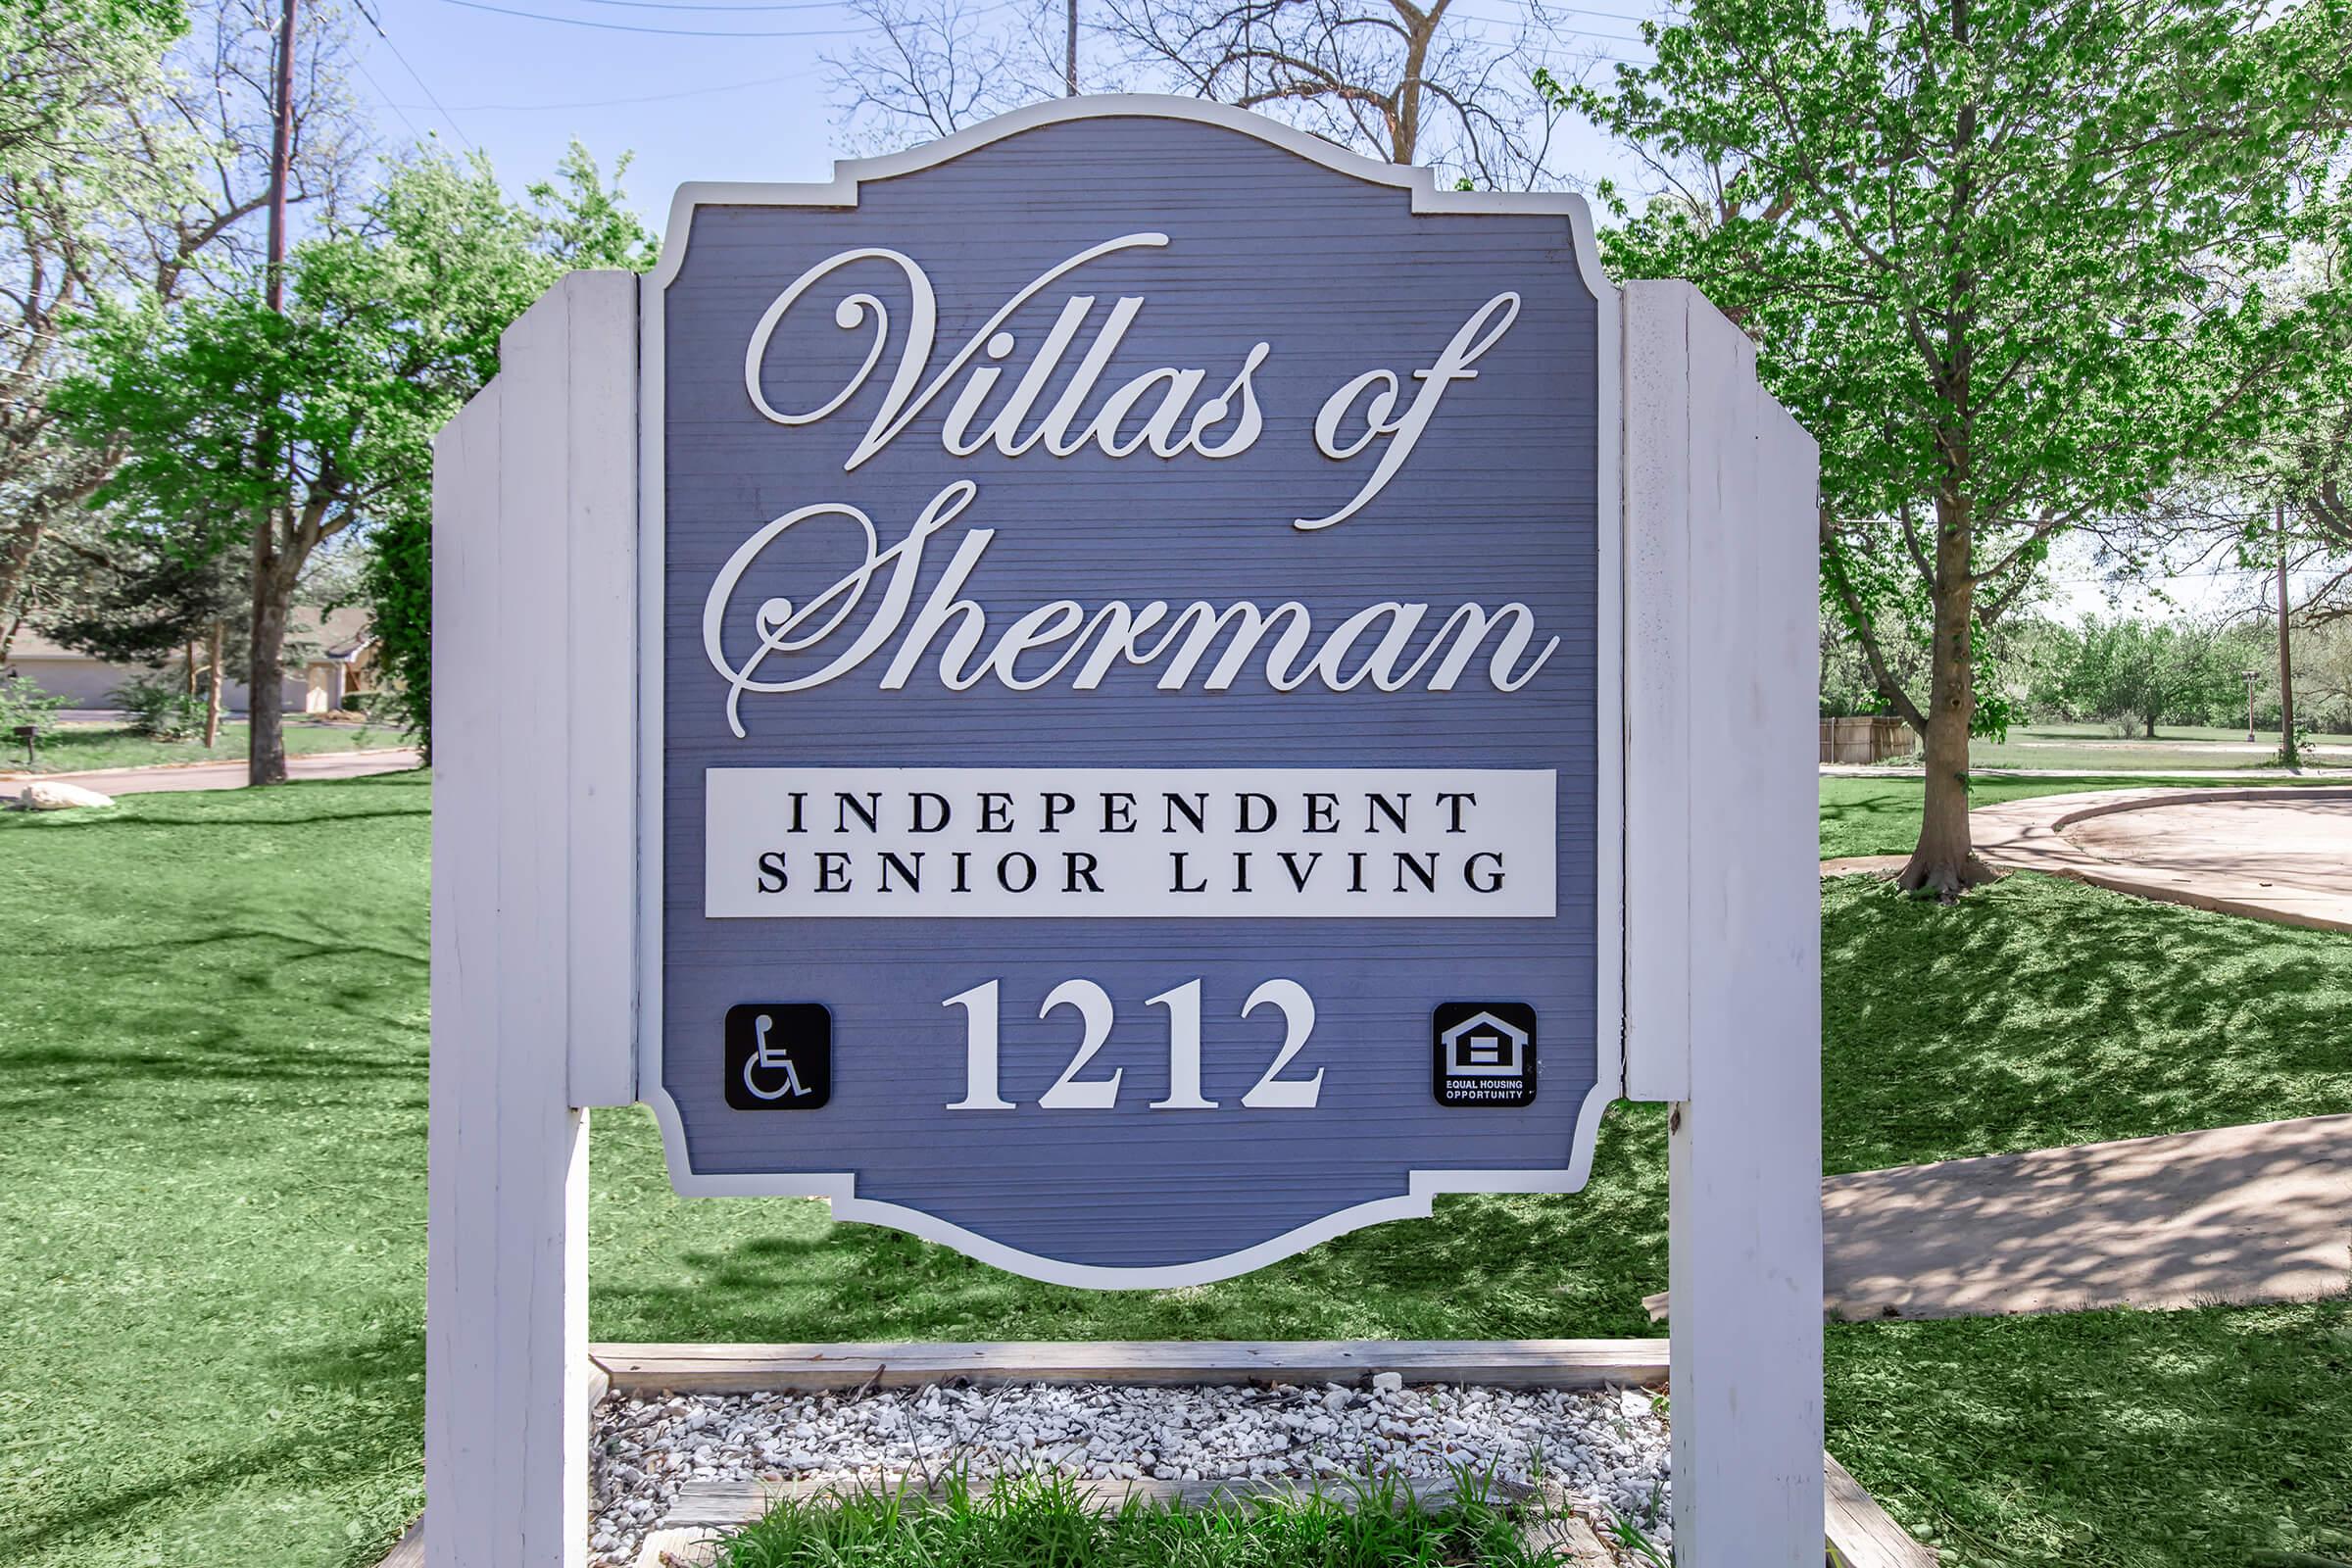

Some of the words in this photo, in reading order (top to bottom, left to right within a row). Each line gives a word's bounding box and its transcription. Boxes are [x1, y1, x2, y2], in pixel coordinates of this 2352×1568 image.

[745, 232, 1270, 471] Villas
[1294, 291, 1521, 529] of
[703, 479, 1561, 739] Sherman
[787, 792, 1478, 834] INDEPENDENT
[757, 852, 1104, 894] SENIOR
[1169, 852, 1506, 894] LIVING
[941, 978, 1325, 1109] 1212
[1446, 1080, 1478, 1090] EQUAL
[1480, 1080, 1523, 1090] HOUSING
[1446, 1090, 1523, 1099] OPPORTUNITY
